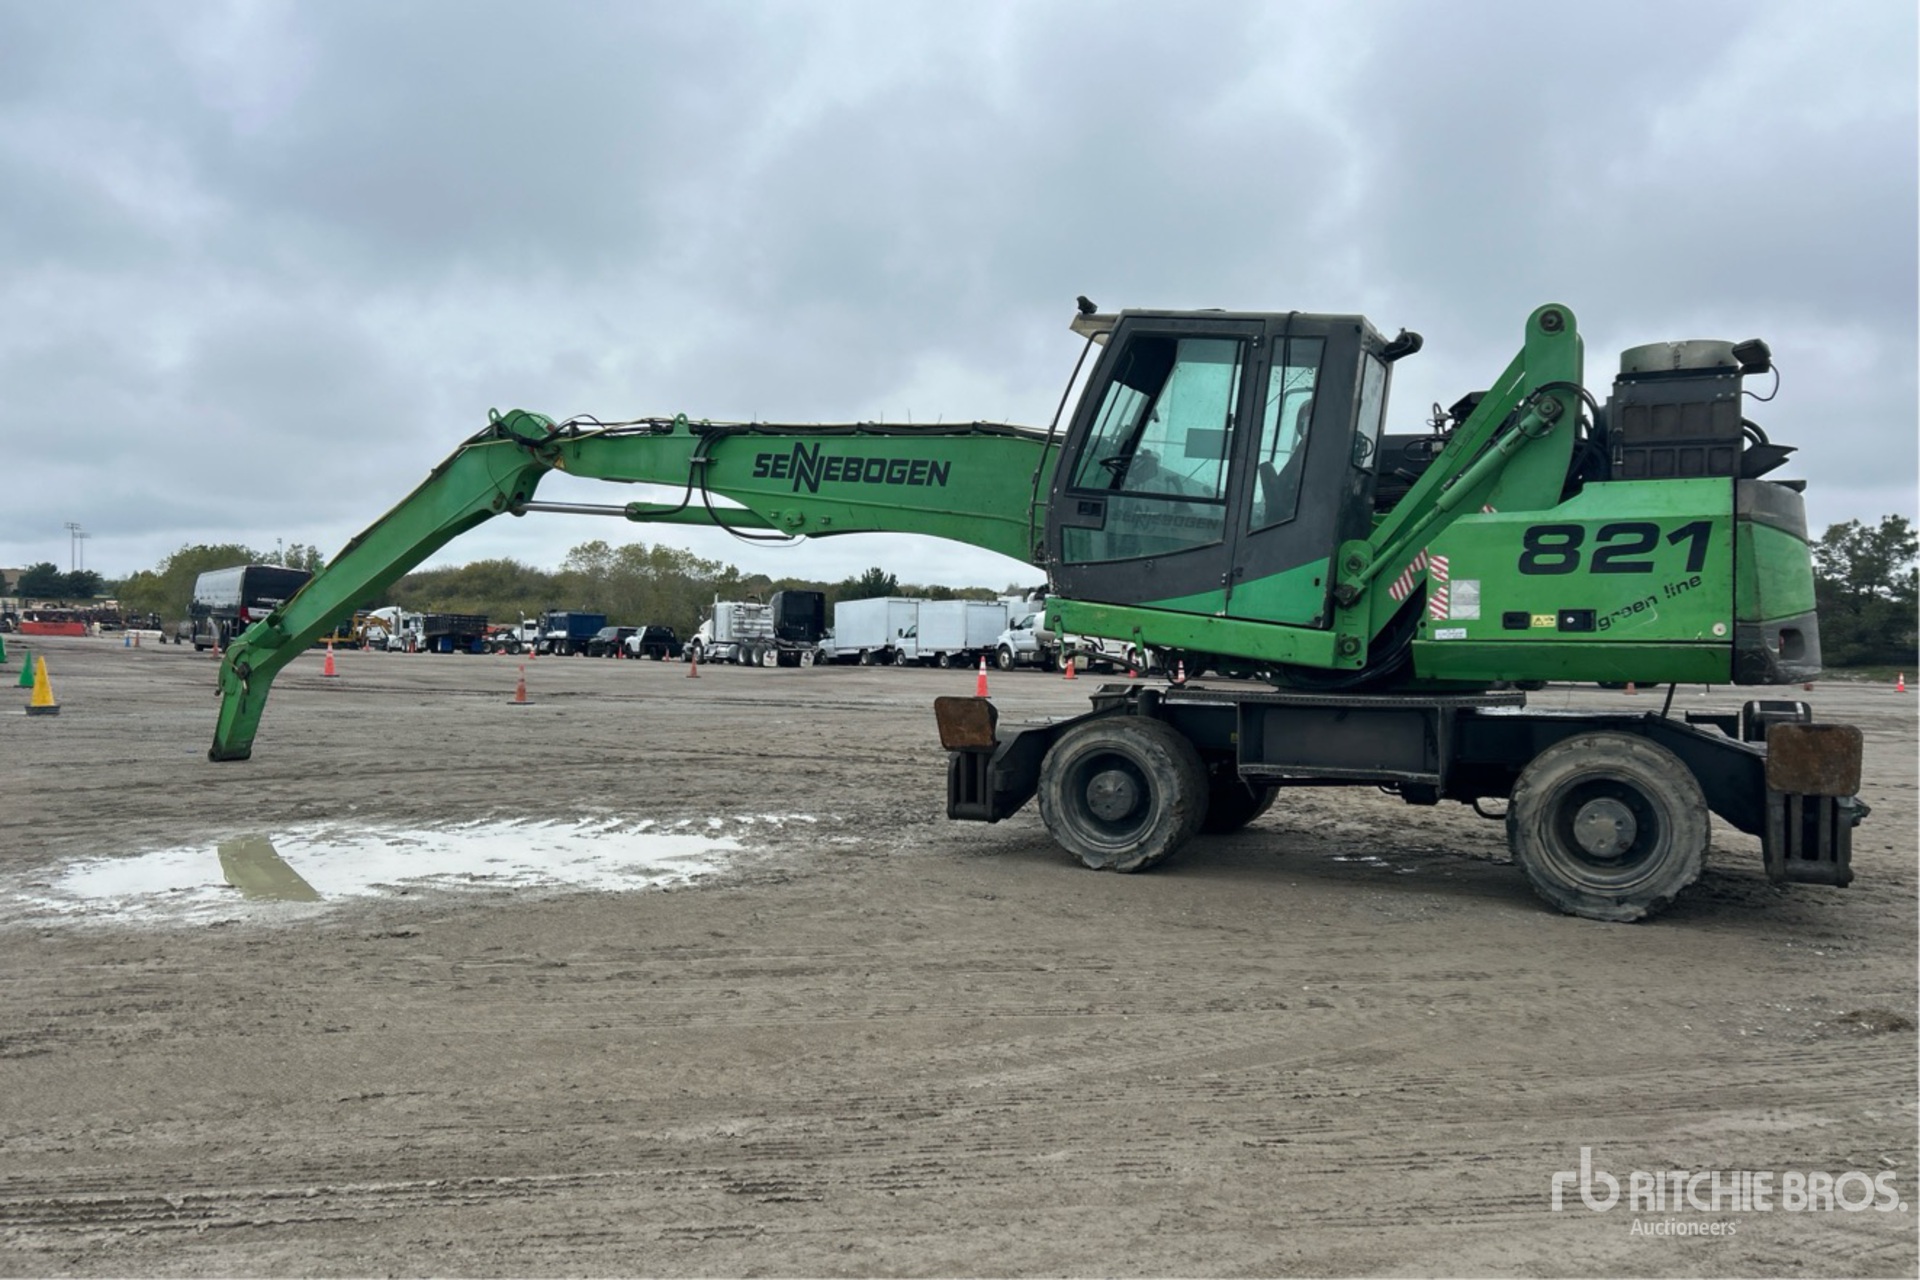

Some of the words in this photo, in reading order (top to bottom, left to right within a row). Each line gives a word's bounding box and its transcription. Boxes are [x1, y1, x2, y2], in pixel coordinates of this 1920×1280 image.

[752, 442, 951, 493] SENNEBOGEN
[1518, 521, 1713, 576] 821
[1598, 595, 1658, 631] green
[1663, 575, 1702, 599] line
